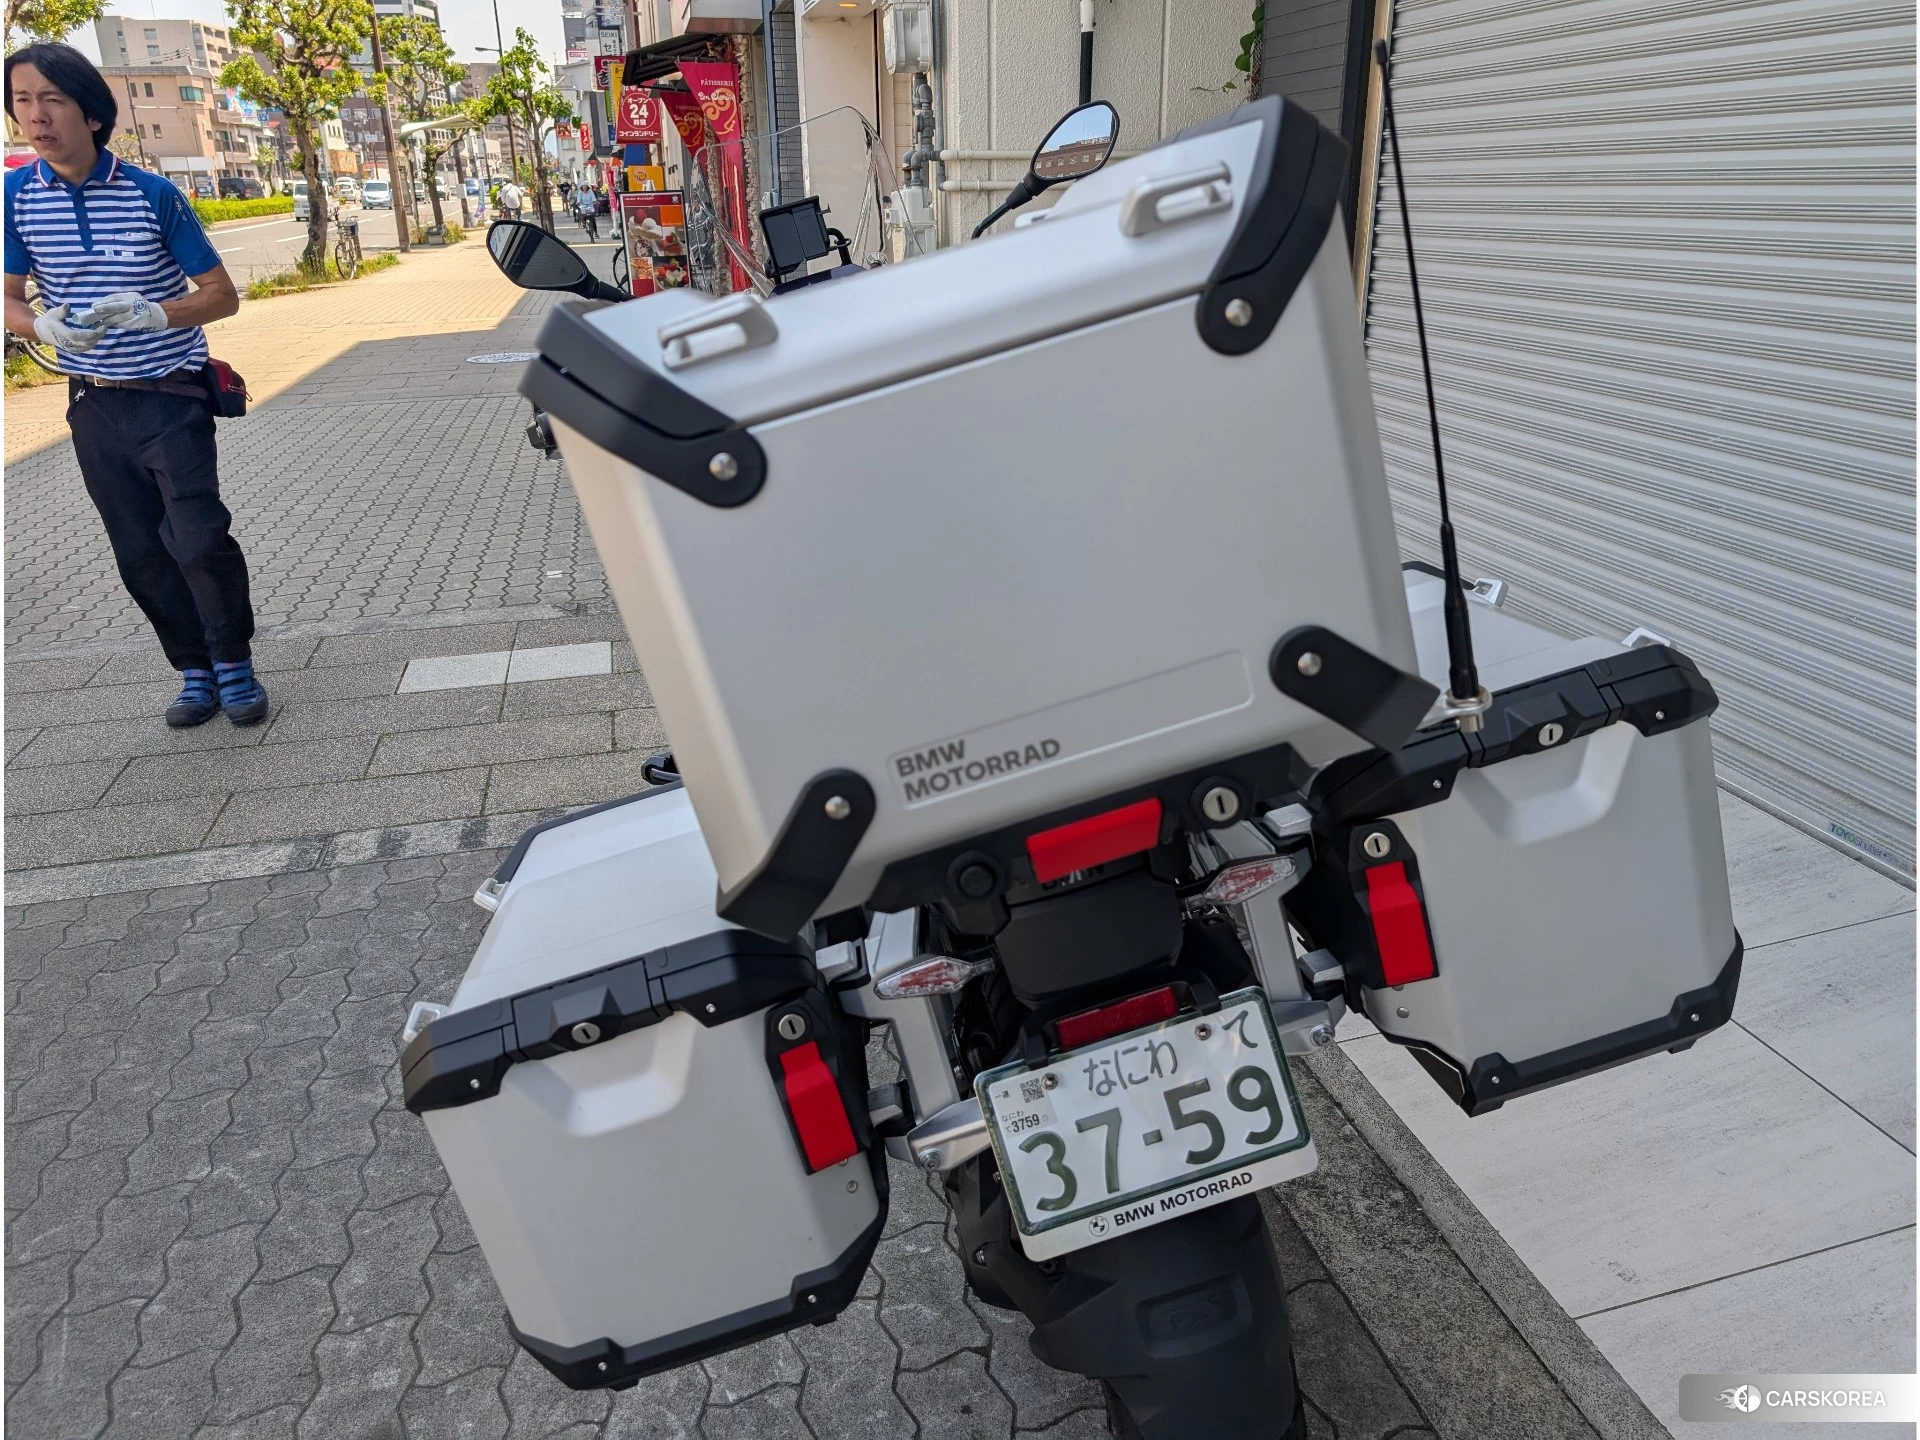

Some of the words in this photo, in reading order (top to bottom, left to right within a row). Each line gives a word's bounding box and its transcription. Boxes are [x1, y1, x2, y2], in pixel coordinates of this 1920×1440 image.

[627, 97, 650, 105] オープン
[629, 104, 649, 119] 24
[895, 739, 965, 777] BMW
[903, 739, 1061, 801] MOTORRAD
[1083, 1039, 1178, 1097] なにわ
[1221, 1010, 1259, 1049] て
[1002, 1109, 1024, 1122] なにわ
[1011, 1114, 1040, 1133] 3759
[1113, 1202, 1155, 1227] BMW
[1160, 1172, 1253, 1212] MOTORRAD
